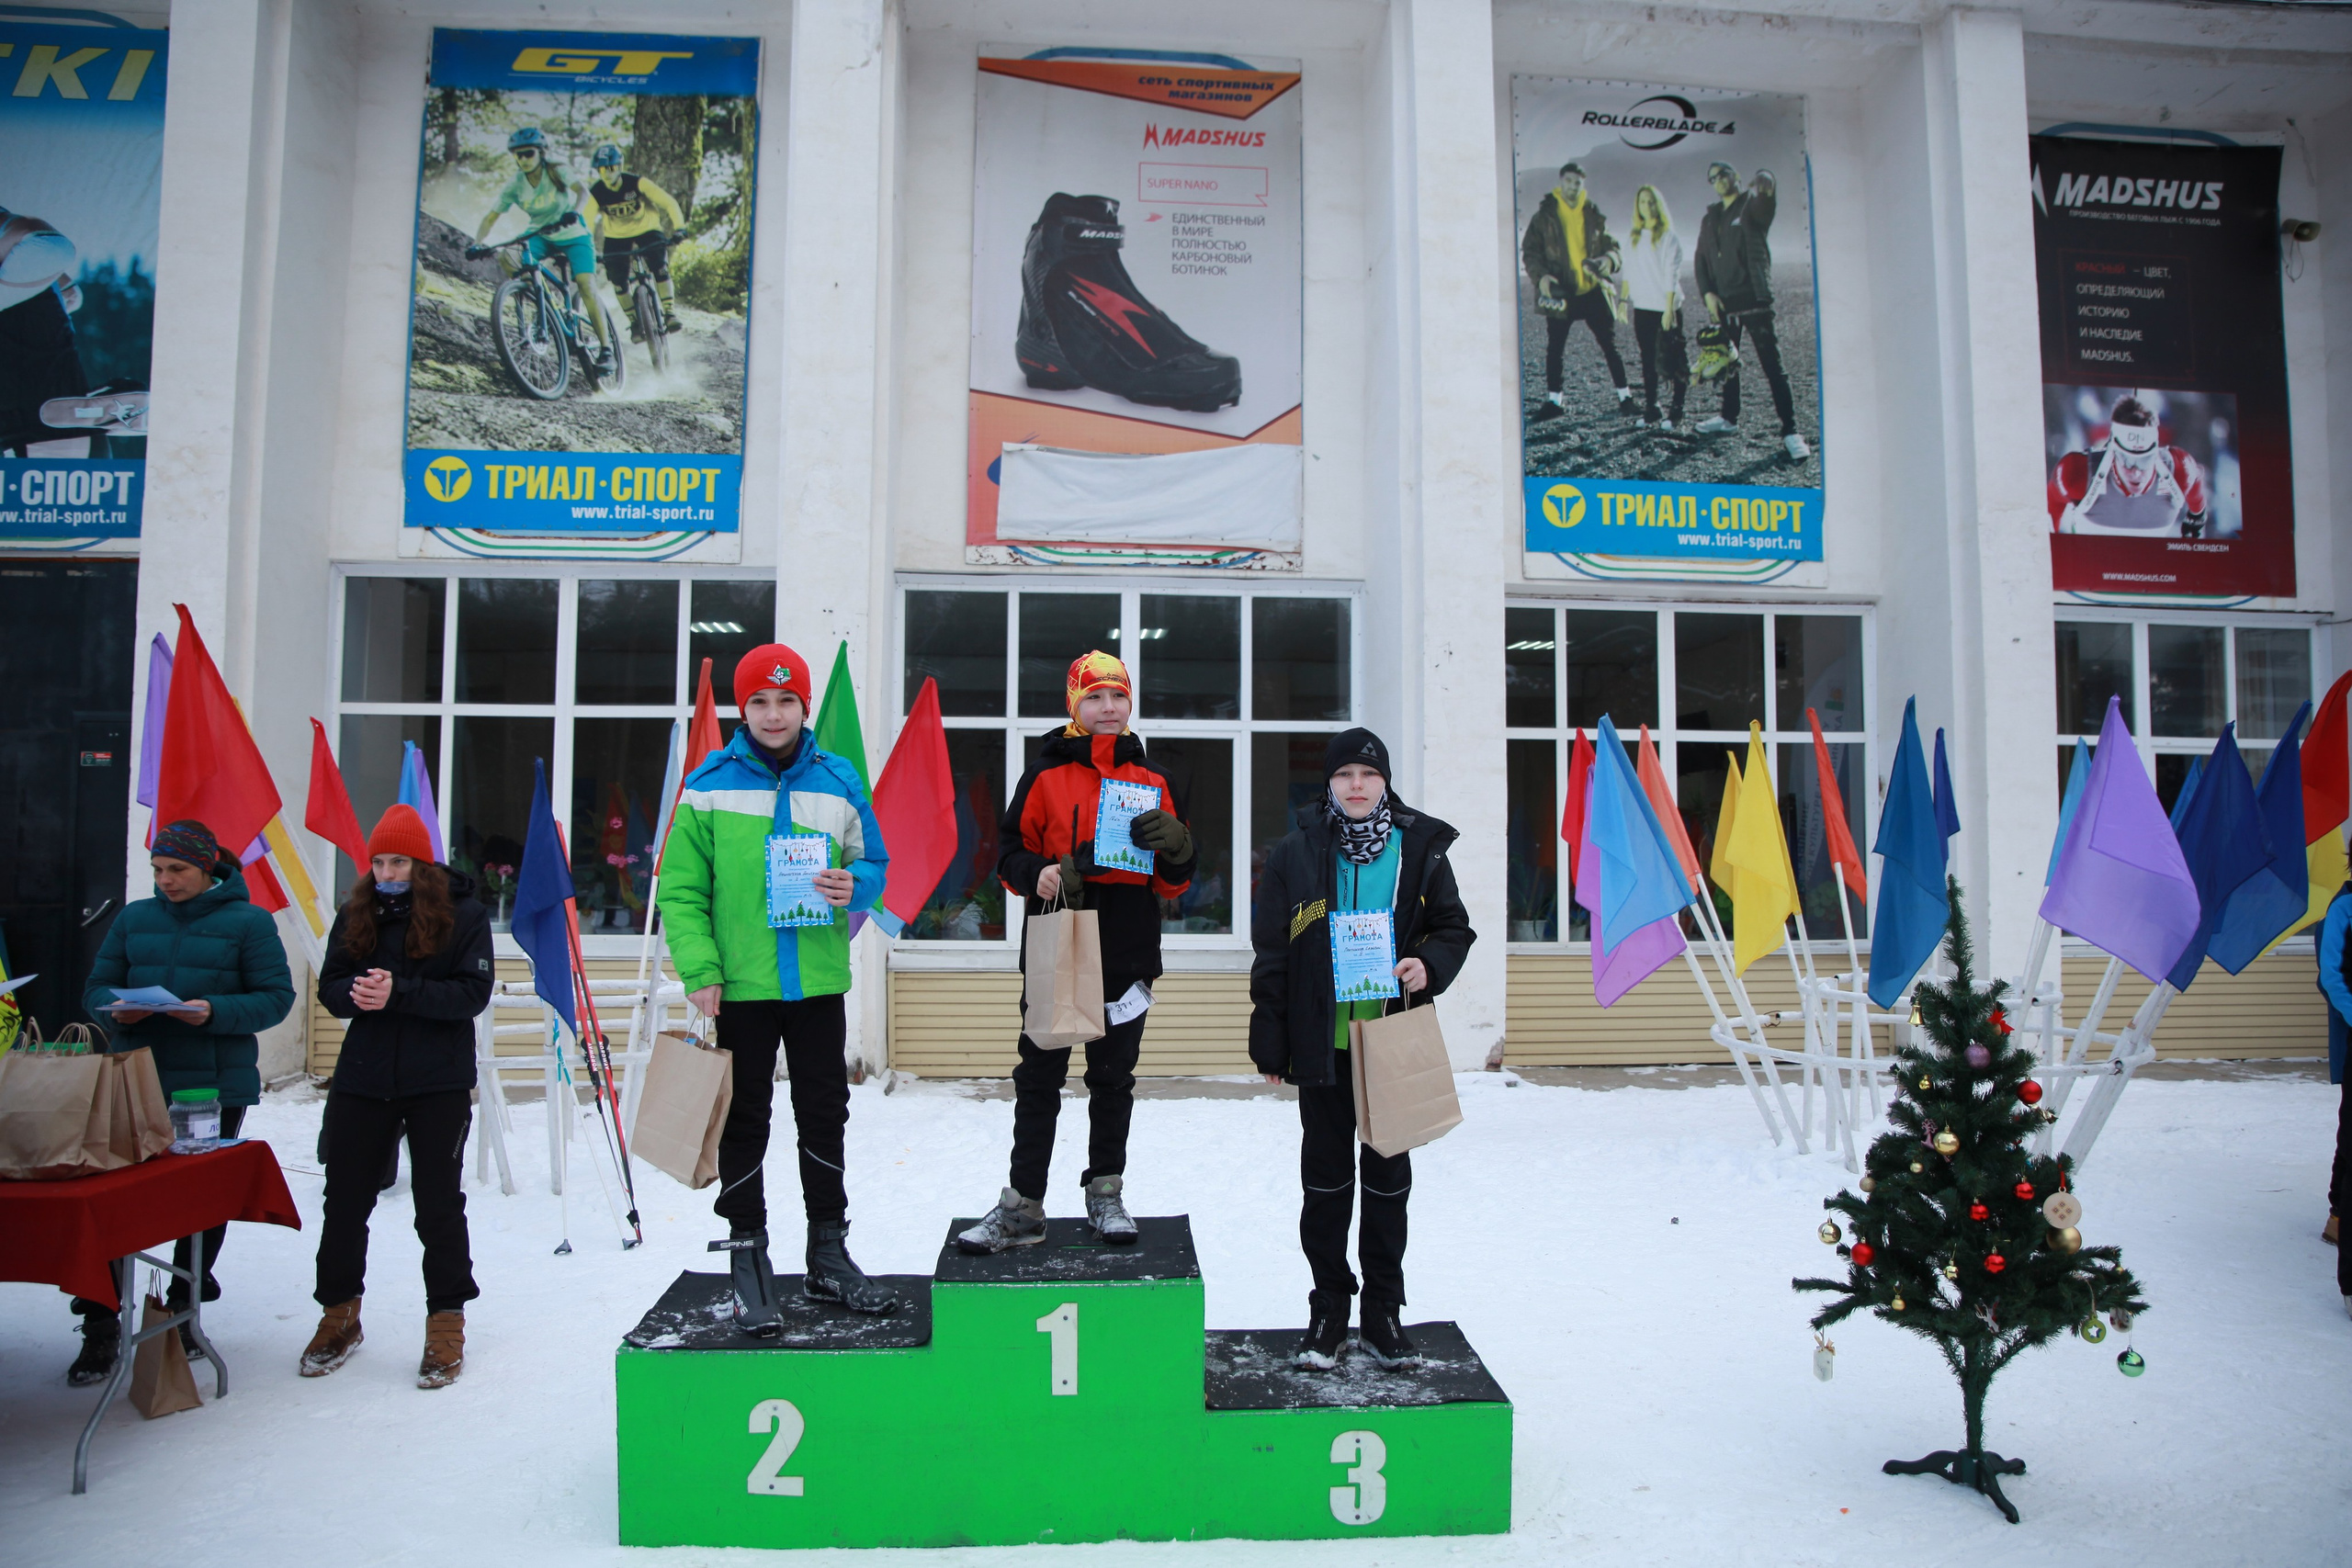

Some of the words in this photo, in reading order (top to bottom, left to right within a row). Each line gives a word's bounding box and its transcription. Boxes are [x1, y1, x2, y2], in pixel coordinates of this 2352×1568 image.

[512, 48, 695, 75] GT
[574, 75, 649, 85] BICYCLES
[1137, 76, 1172, 86] сеть
[1177, 77, 1274, 91] спортивных
[1168, 90, 1252, 102] магазинов
[1581, 110, 1718, 134] ROLLERBLADE
[1161, 128, 1266, 147] MADSHUS
[1148, 178, 1182, 189] SUPER
[1183, 180, 1218, 191] NANO
[2053, 172, 2223, 210] MADSHUS
[1171, 212, 1265, 227] ЕДИНСТВЕННЫЙ
[2201, 219, 2222, 227] ГОДА
[1171, 227, 1180, 236] В
[1182, 227, 1214, 237] МИРЕ
[1171, 239, 1247, 251] ПОЛНОСТЬЮ
[1171, 251, 1252, 264] КАРБОНОВЫЙ
[1171, 264, 1227, 276] БОТИНОК
[2075, 262, 2126, 274] КРАСНЫЙ
[2143, 266, 2171, 279] ЦВЕТ,
[2076, 283, 2165, 299] ОПРЕДЕЛЯЮЩИЙ
[2078, 305, 2130, 319] ИСТОРИЮ
[2079, 327, 2088, 338] И
[2089, 327, 2143, 342] НАСЛЕДИЕ
[2080, 348, 2134, 363] MADSHUS.
[571, 504, 715, 523] www.trial-sport.ru
[1678, 533, 1802, 551] www.trial-sport.ru
[2192, 543, 2230, 553] СВЕНДСЕН
[2102, 572, 2177, 583] WWW.MADSHUS.COM
[777, 859, 820, 867] ГРАМОТА
[1341, 933, 1384, 942] ГРАМОТА
[719, 1239, 754, 1249] SPINE
[1035, 1303, 1079, 1395] 1
[747, 1398, 806, 1497] 2
[1329, 1429, 1386, 1526] 3
